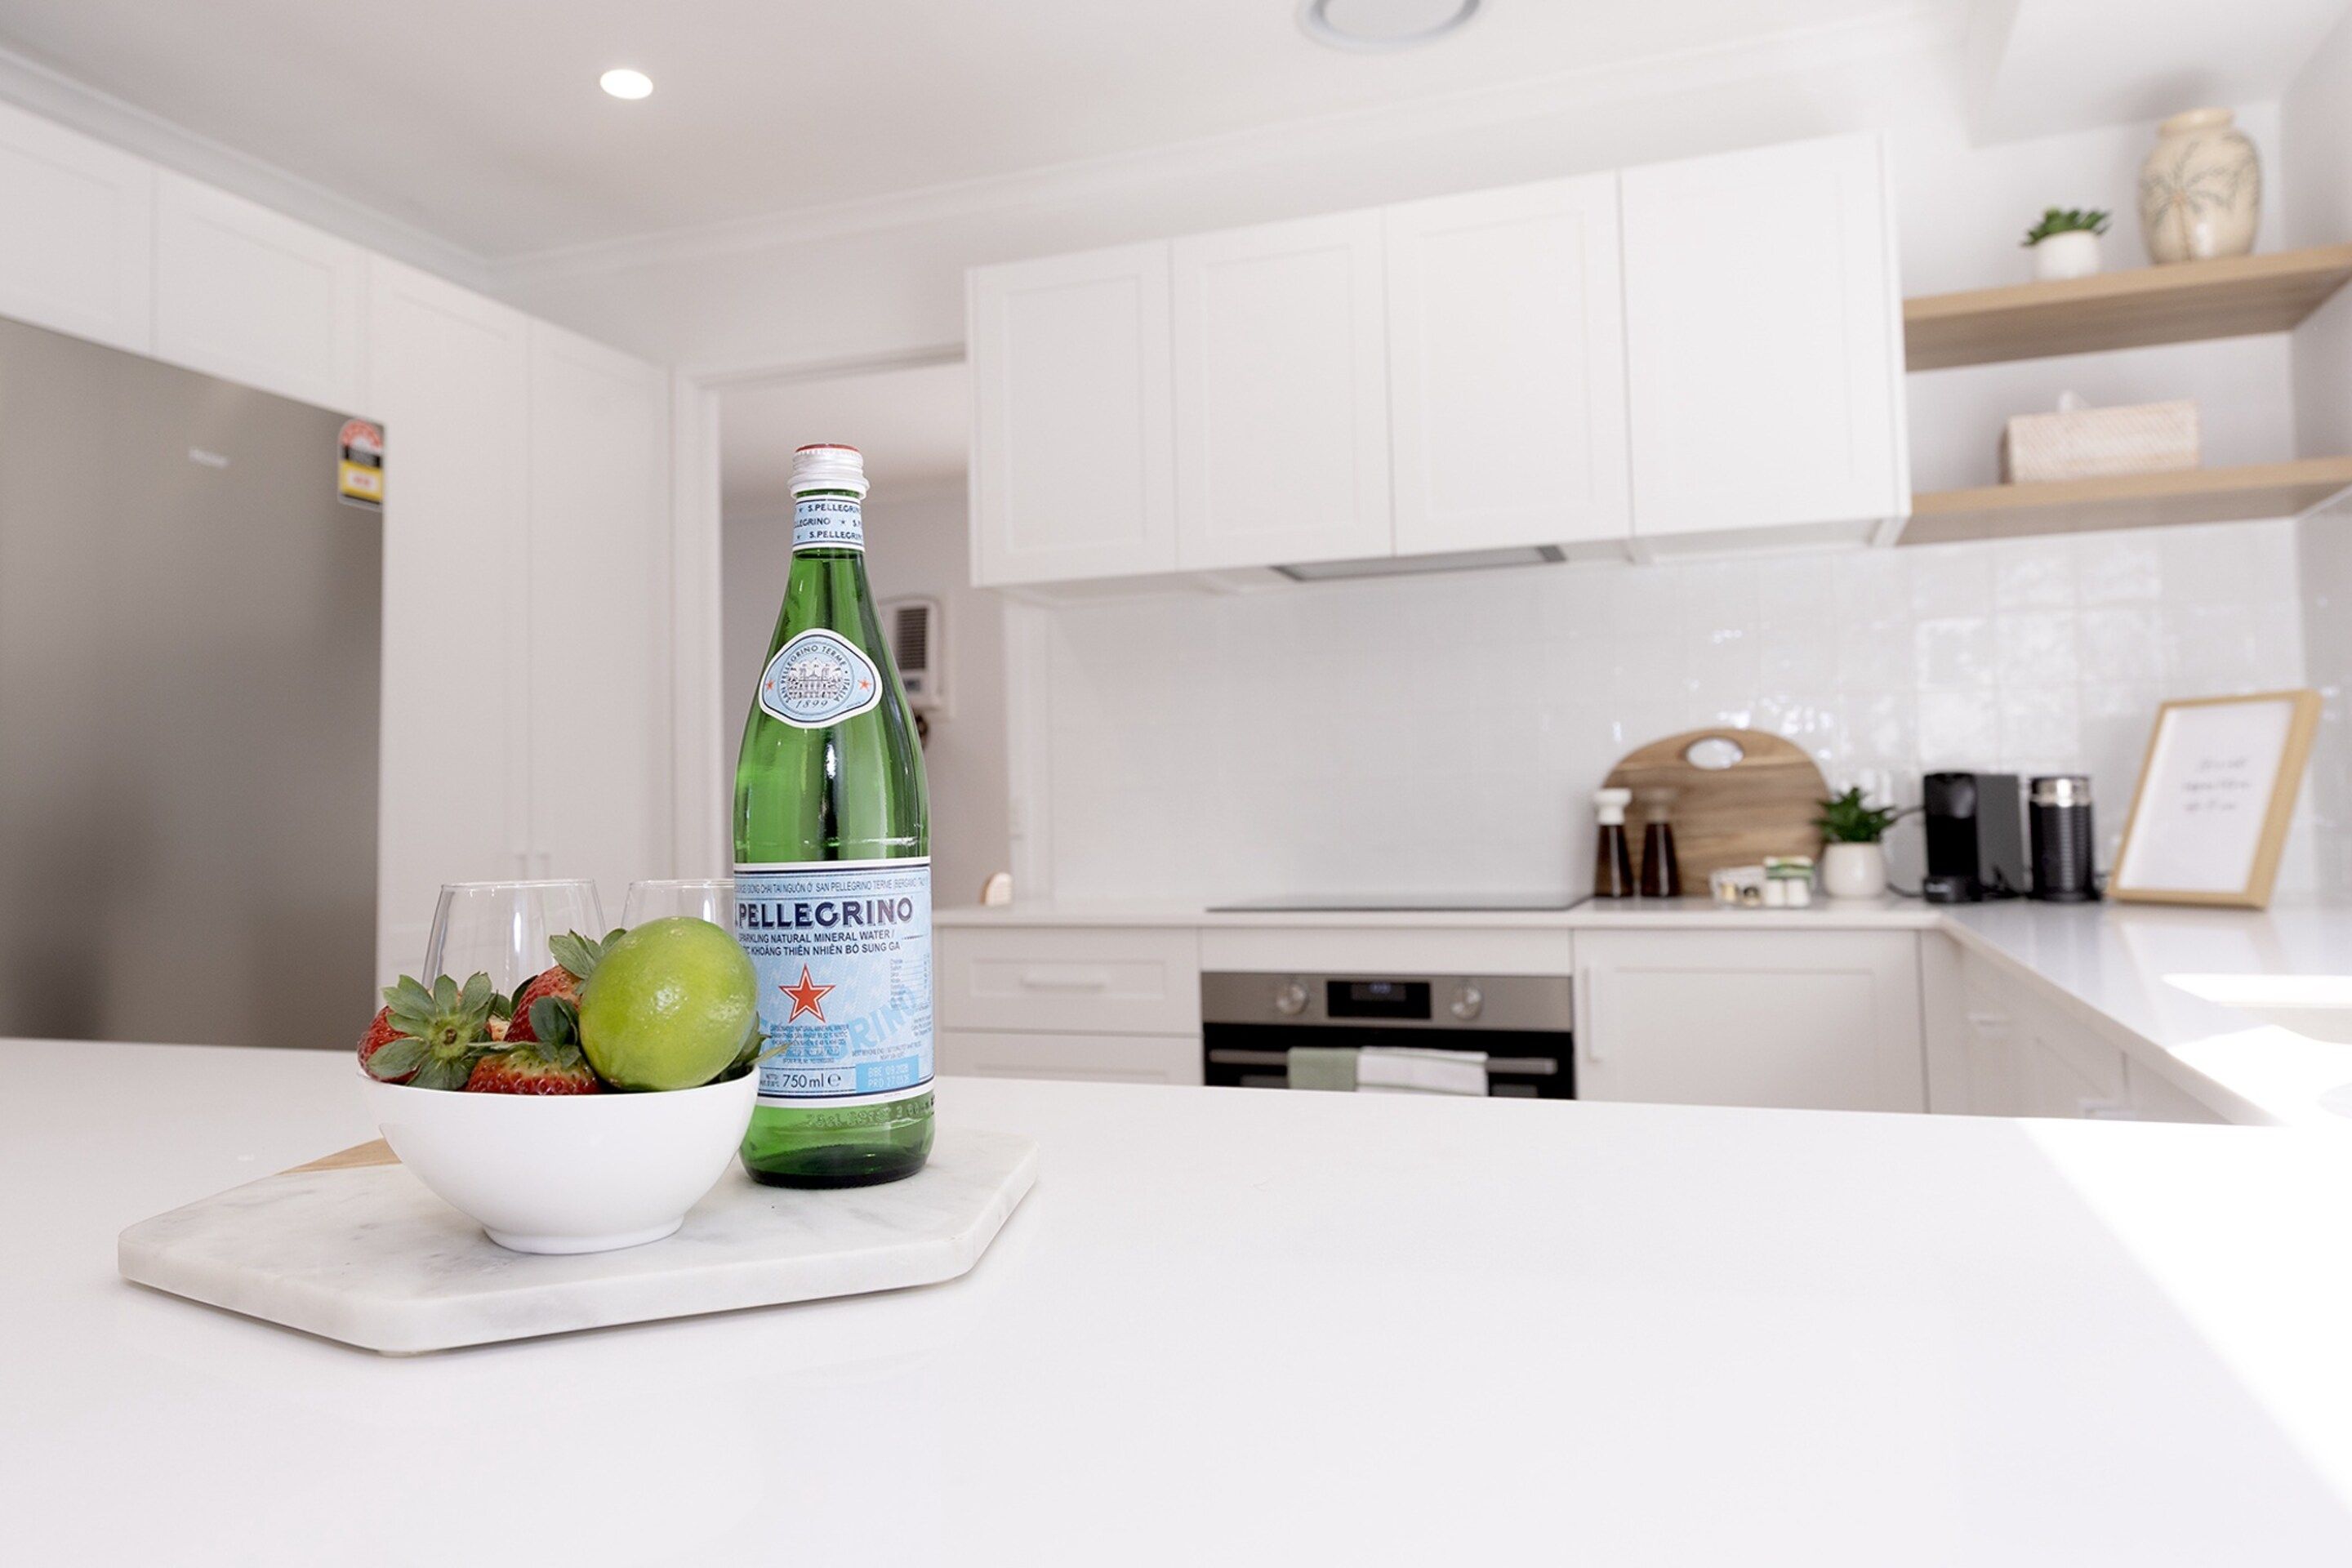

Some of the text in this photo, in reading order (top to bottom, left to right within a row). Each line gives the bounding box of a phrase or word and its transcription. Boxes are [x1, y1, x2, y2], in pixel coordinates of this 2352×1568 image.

[795, 700, 828, 709] 1899
[815, 882, 830, 892] SAN
[831, 880, 872, 892] PELLEGRINO
[771, 933, 812, 943] NATURAL
[814, 932, 858, 942] MINERAL
[859, 929, 890, 940] WATER
[862, 942, 886, 953] SUNG
[889, 942, 901, 951] GA
